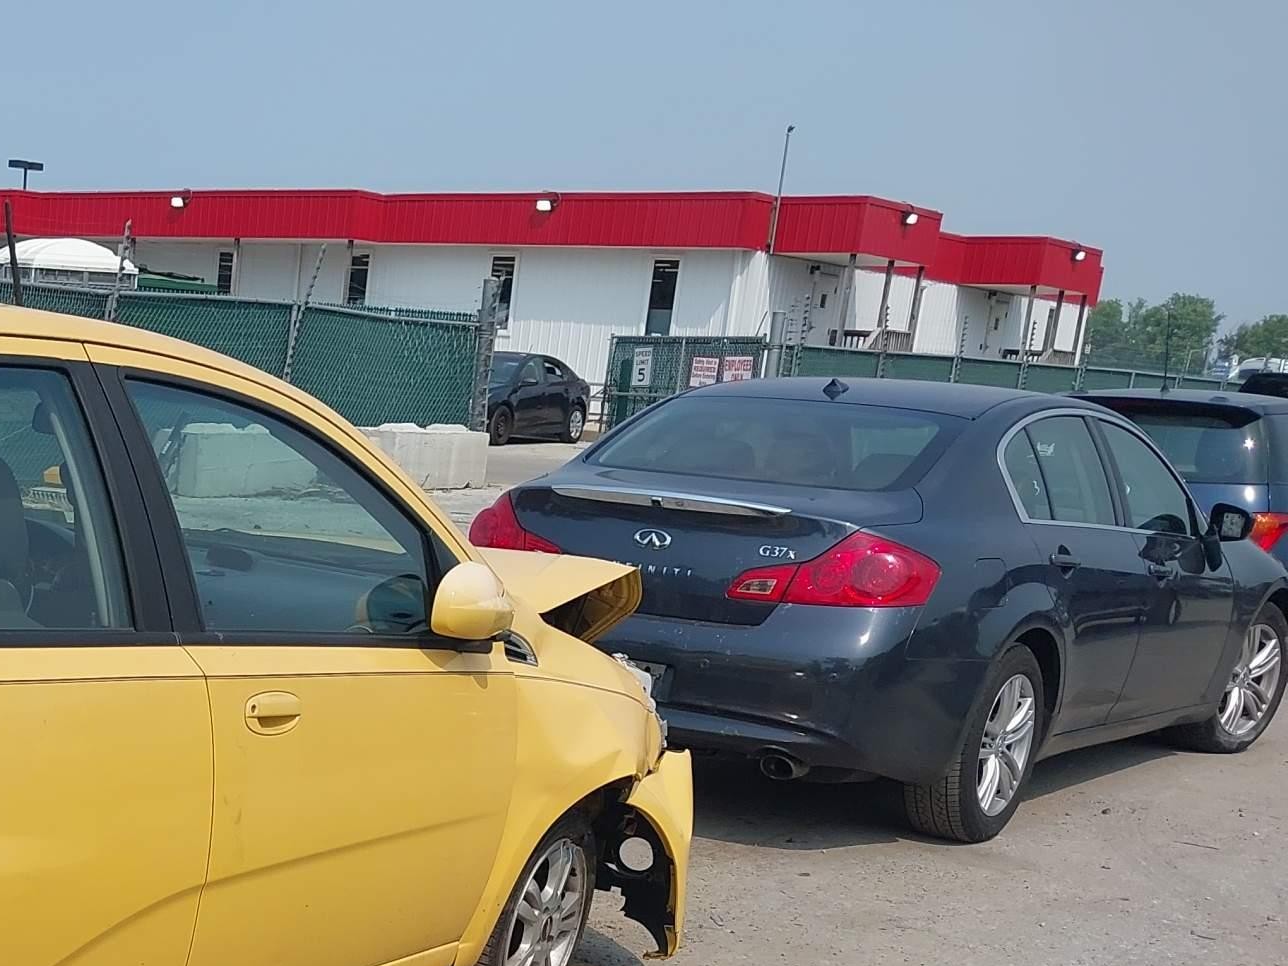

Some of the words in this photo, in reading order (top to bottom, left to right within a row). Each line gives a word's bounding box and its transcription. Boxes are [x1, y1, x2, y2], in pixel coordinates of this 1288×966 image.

[725, 359, 752, 372] EMPLOYEES
[637, 368, 646, 383] 5
[759, 545, 796, 560] G37x
[613, 560, 693, 577] INITI
